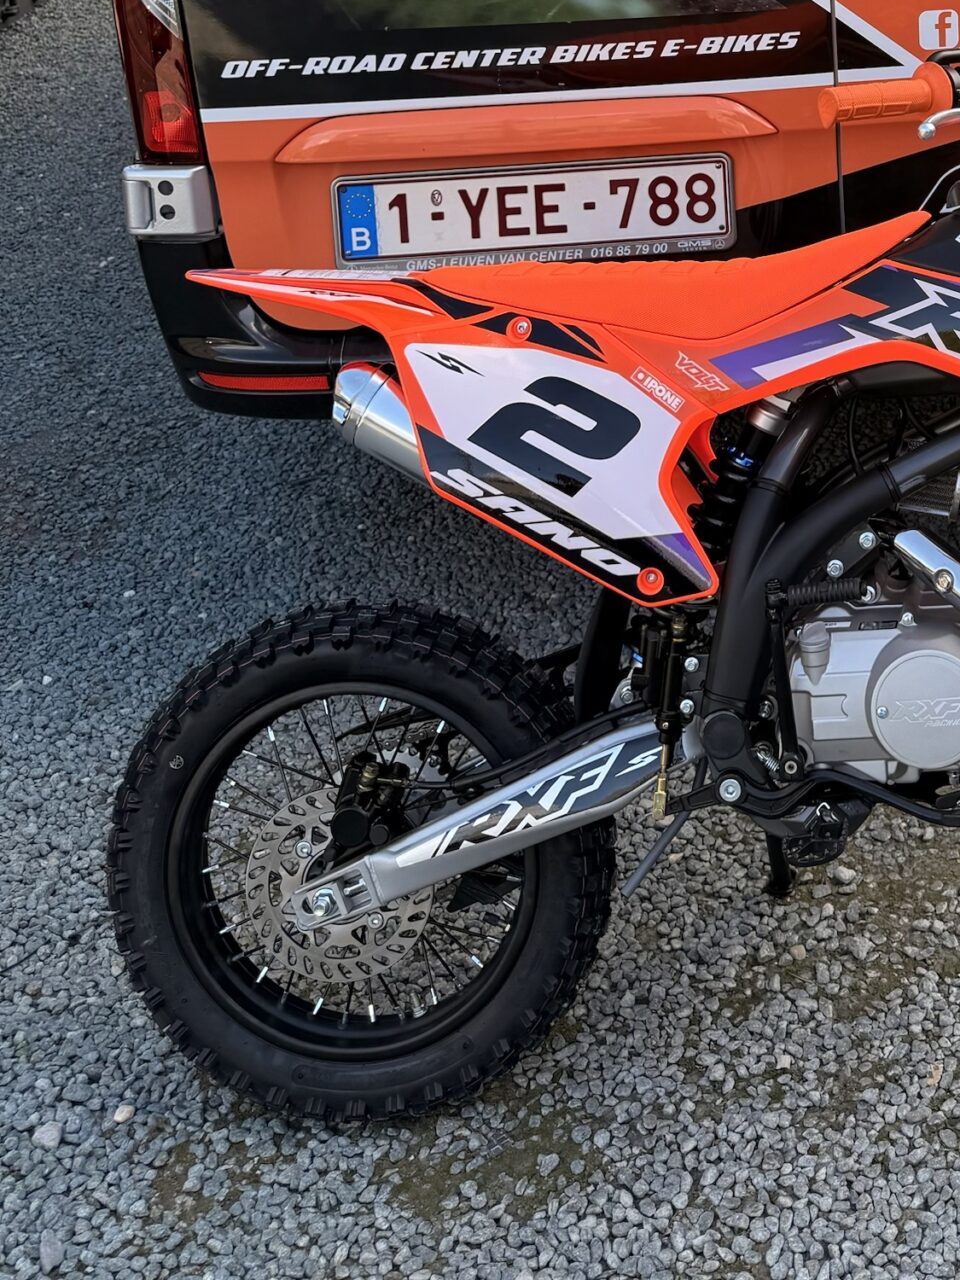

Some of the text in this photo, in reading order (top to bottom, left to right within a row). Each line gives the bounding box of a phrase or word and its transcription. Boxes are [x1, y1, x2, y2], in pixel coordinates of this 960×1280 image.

[220, 31, 801, 79] OFF-ROAD CENTER BIKES E-BIKES
[350, 226, 372, 252] B
[405, 242, 668, 271] GMS-LEUVEN VAN CENTER 016 85 79 00
[642, 376, 682, 410] IPONE
[468, 375, 642, 498] 2
[430, 467, 642, 578] SANO
